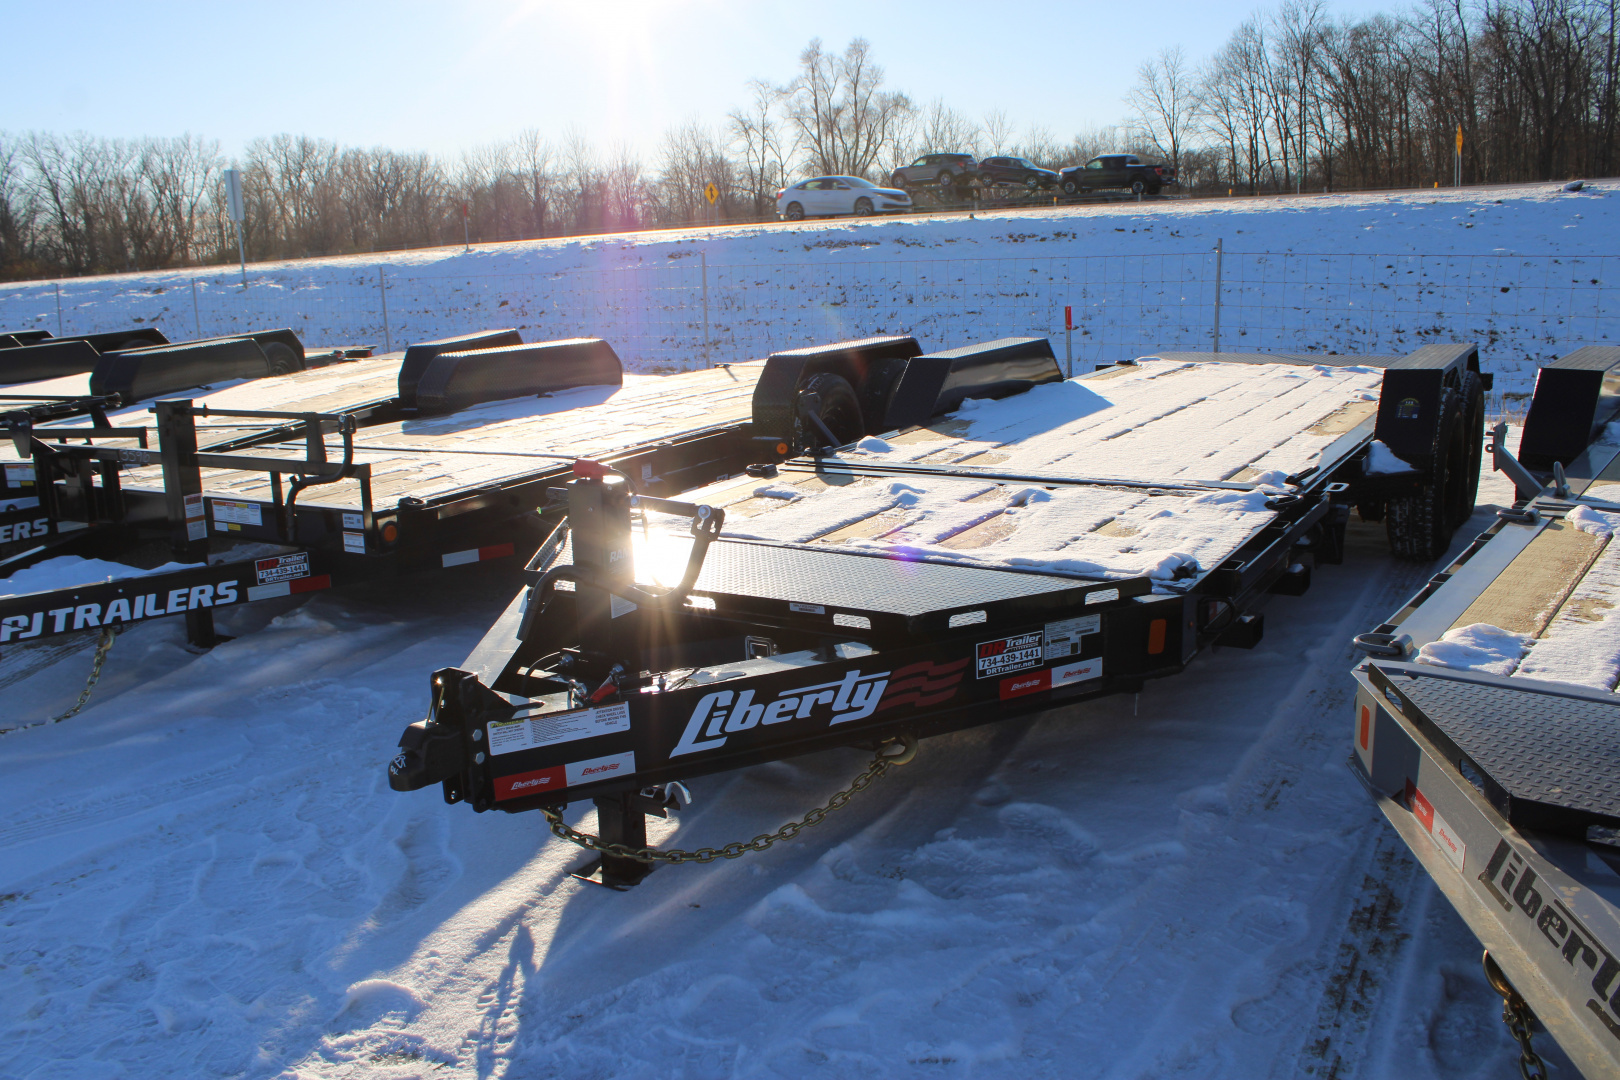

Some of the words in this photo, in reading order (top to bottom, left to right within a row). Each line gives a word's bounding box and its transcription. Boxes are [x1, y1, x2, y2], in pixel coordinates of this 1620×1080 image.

[260, 565, 305, 577] 734-439-1441
[0, 612, 44, 641] PJ
[48, 580, 238, 633] TRAILERS
[980, 640, 1006, 657] DR
[1006, 635, 1041, 648] Trailer
[981, 649, 1040, 668] 734-439-1441
[986, 660, 1035, 675] DRTrailer.net
[668, 669, 891, 759] Liberty
[582, 765, 608, 776] Liberty
[511, 779, 539, 790] Liberty
